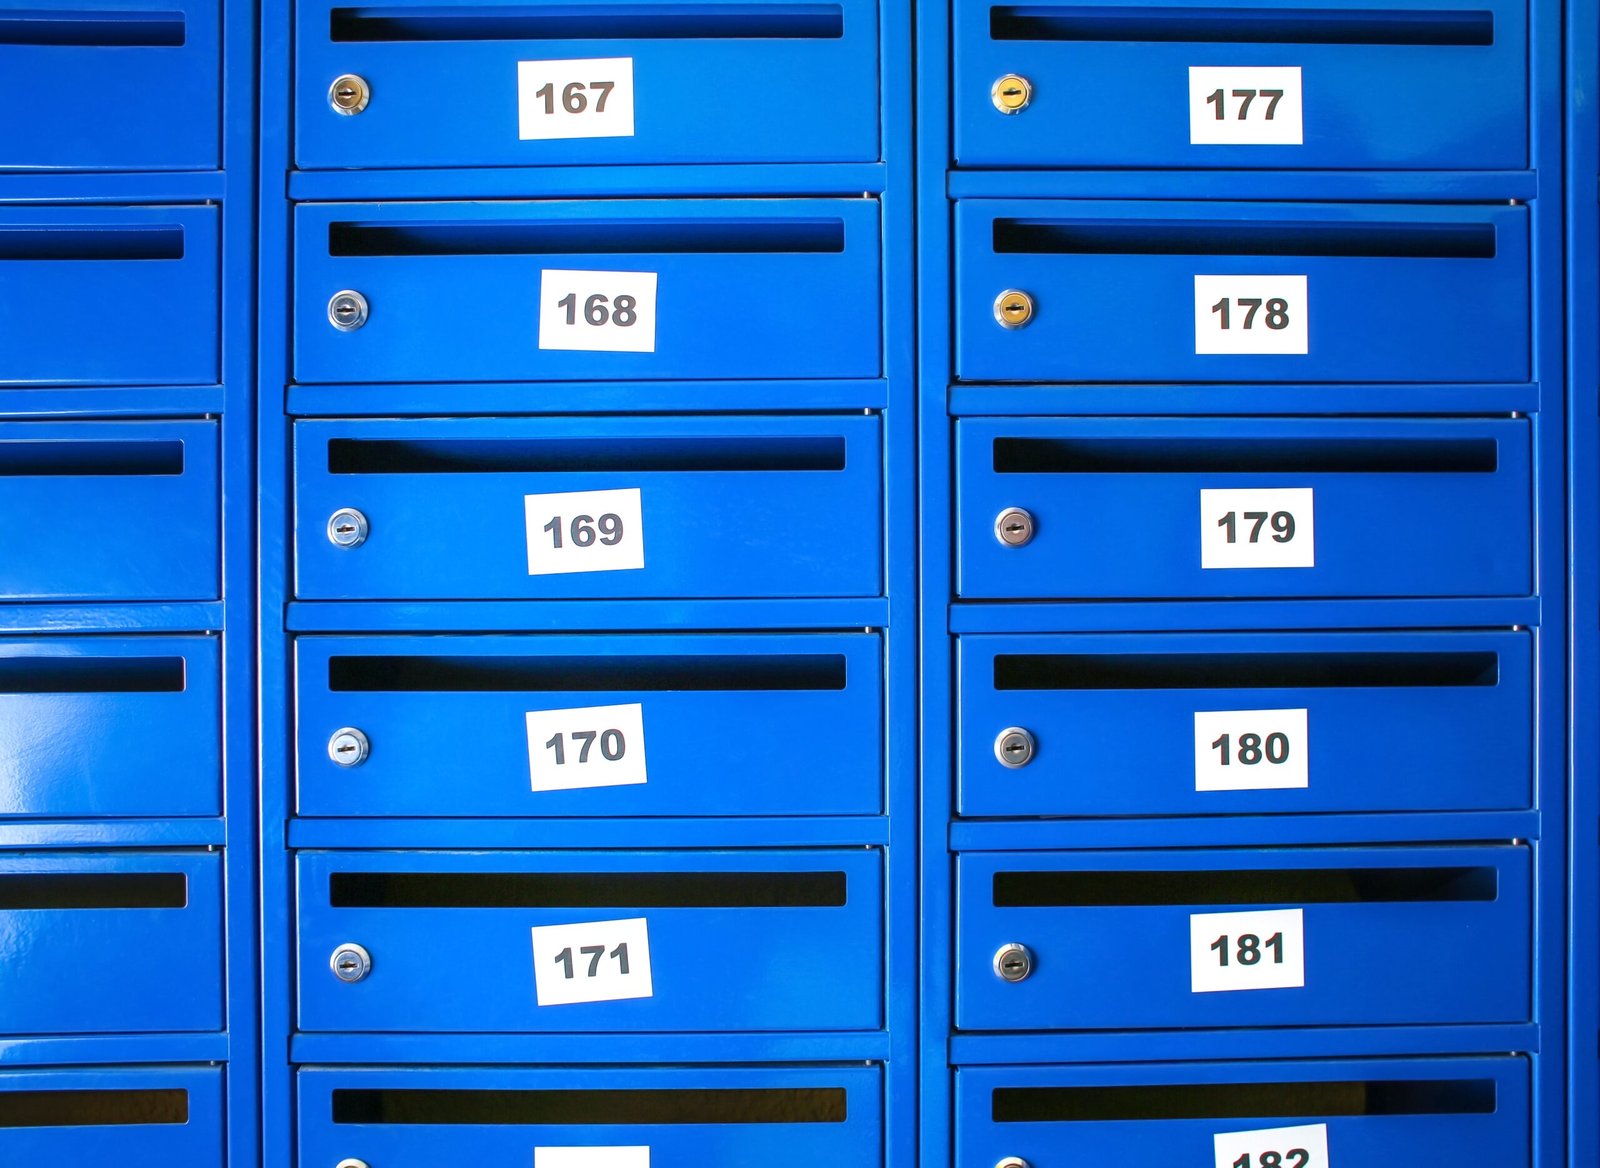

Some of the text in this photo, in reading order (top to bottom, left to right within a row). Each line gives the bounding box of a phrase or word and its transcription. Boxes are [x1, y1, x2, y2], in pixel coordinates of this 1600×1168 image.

[536, 82, 615, 114] 167
[1206, 89, 1284, 121] 177
[558, 294, 637, 327] 168
[1212, 298, 1290, 330] 178
[544, 514, 624, 548] 169
[1218, 511, 1296, 543] 179
[546, 729, 626, 764] 170
[1211, 732, 1290, 765] 180
[554, 943, 630, 978] 171
[1210, 931, 1283, 966] 181
